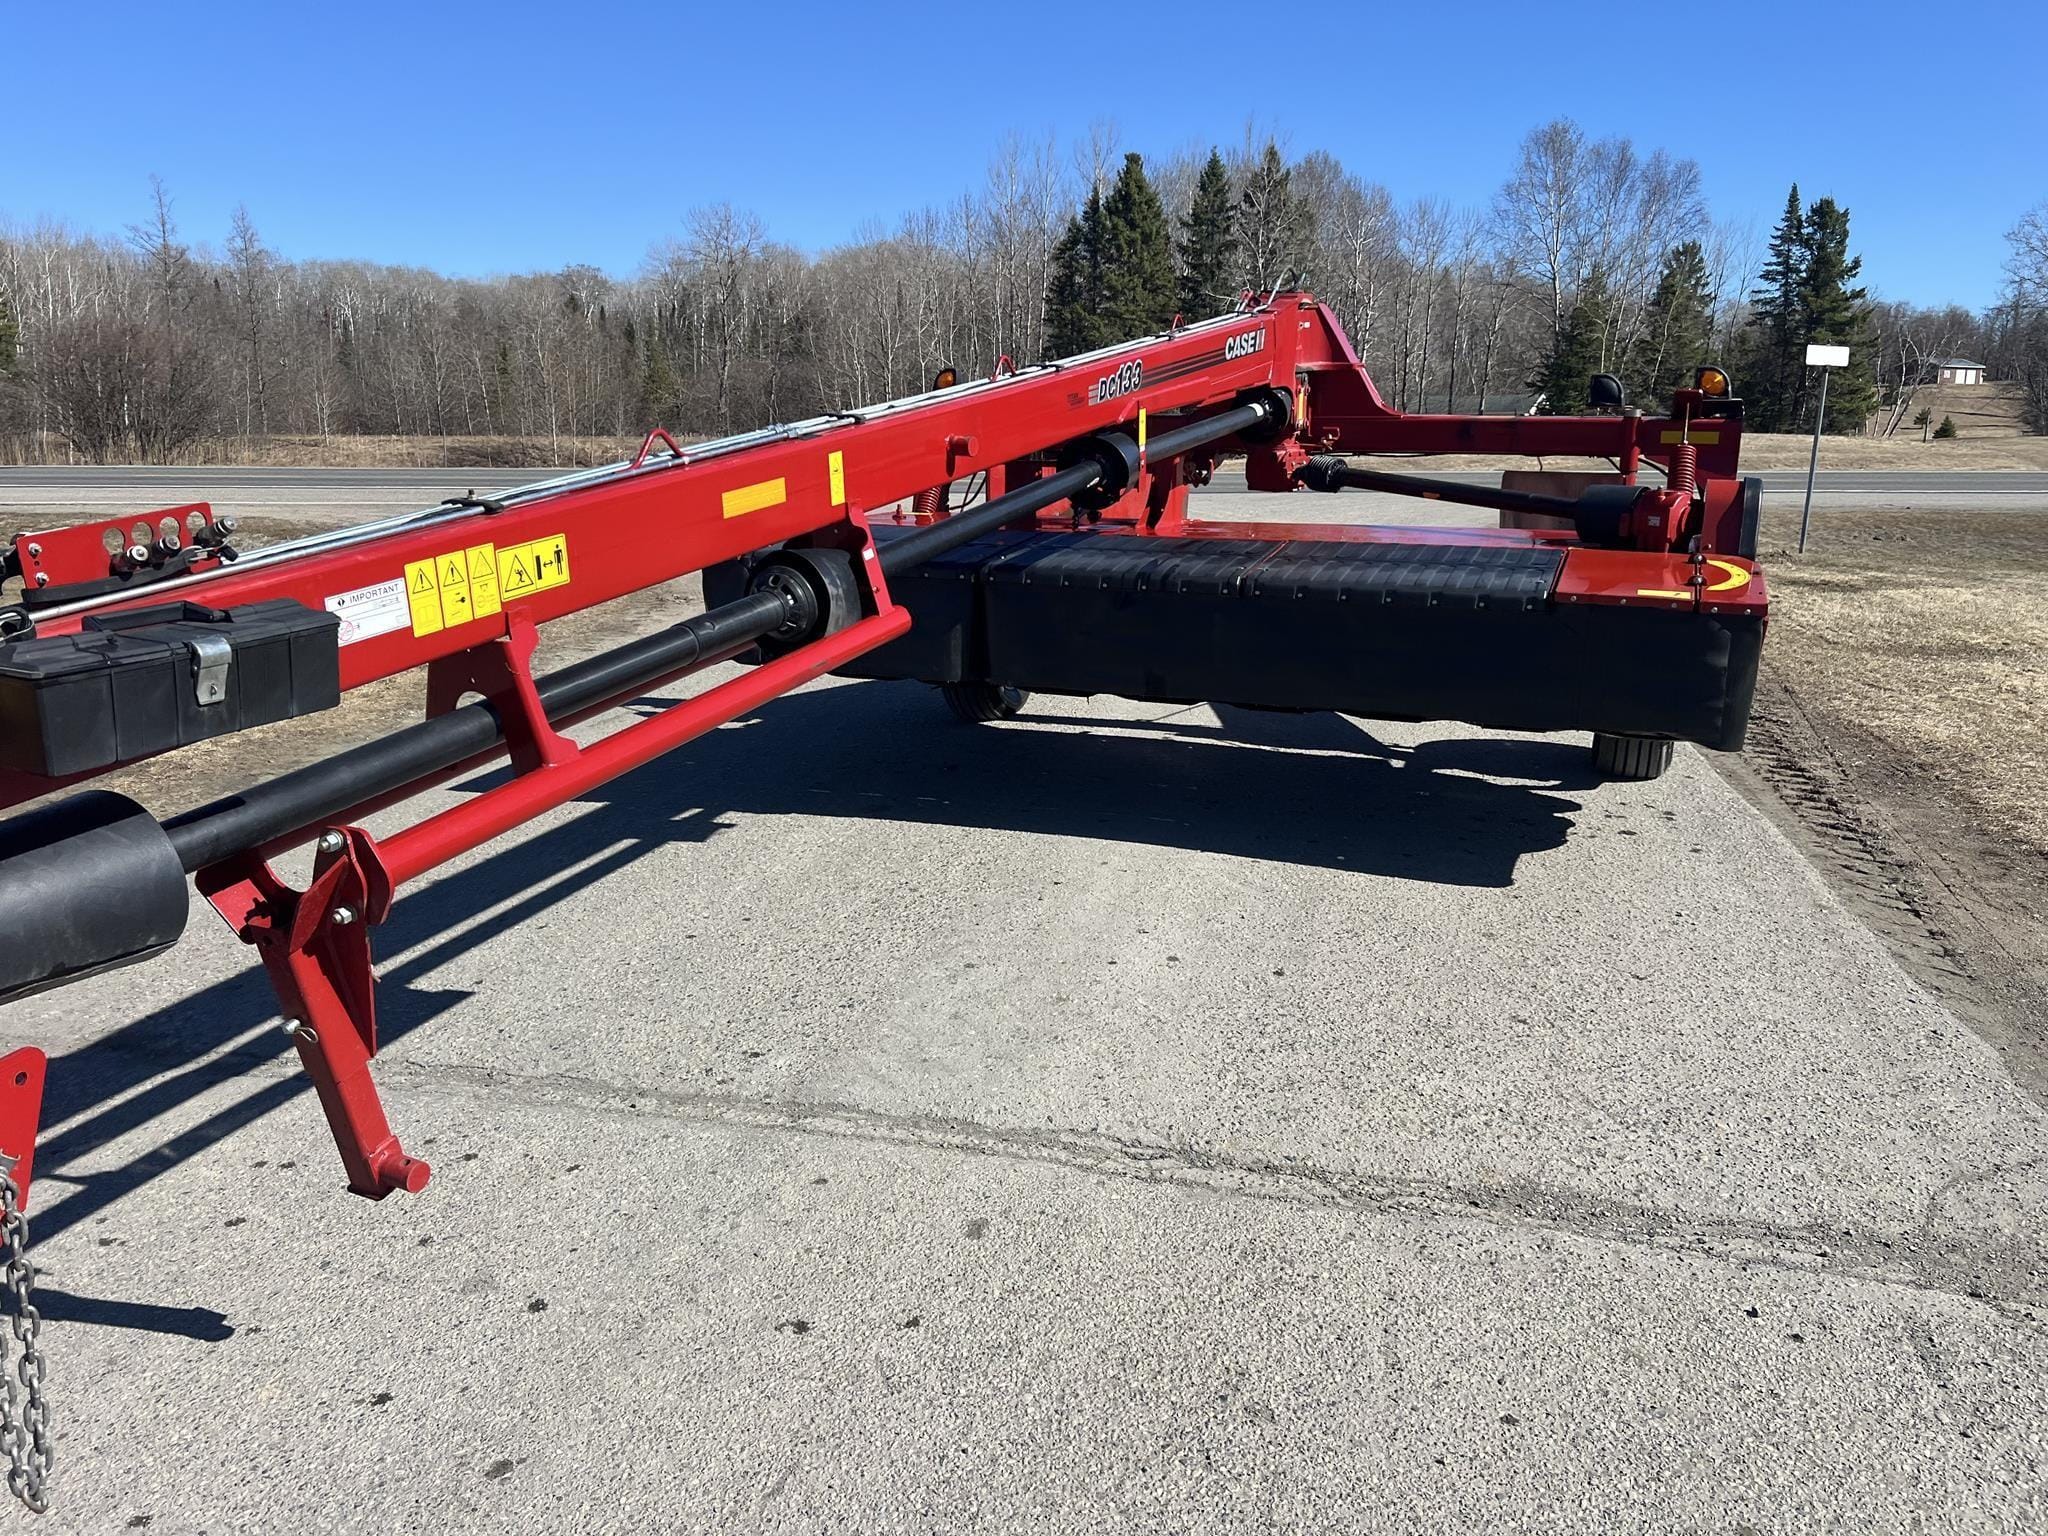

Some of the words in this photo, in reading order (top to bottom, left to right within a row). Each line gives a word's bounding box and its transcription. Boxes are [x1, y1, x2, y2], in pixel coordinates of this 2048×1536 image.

[1225, 331, 1256, 360] CASE
[1097, 358, 1143, 403] DC133
[349, 583, 400, 604] IMPORTANT
